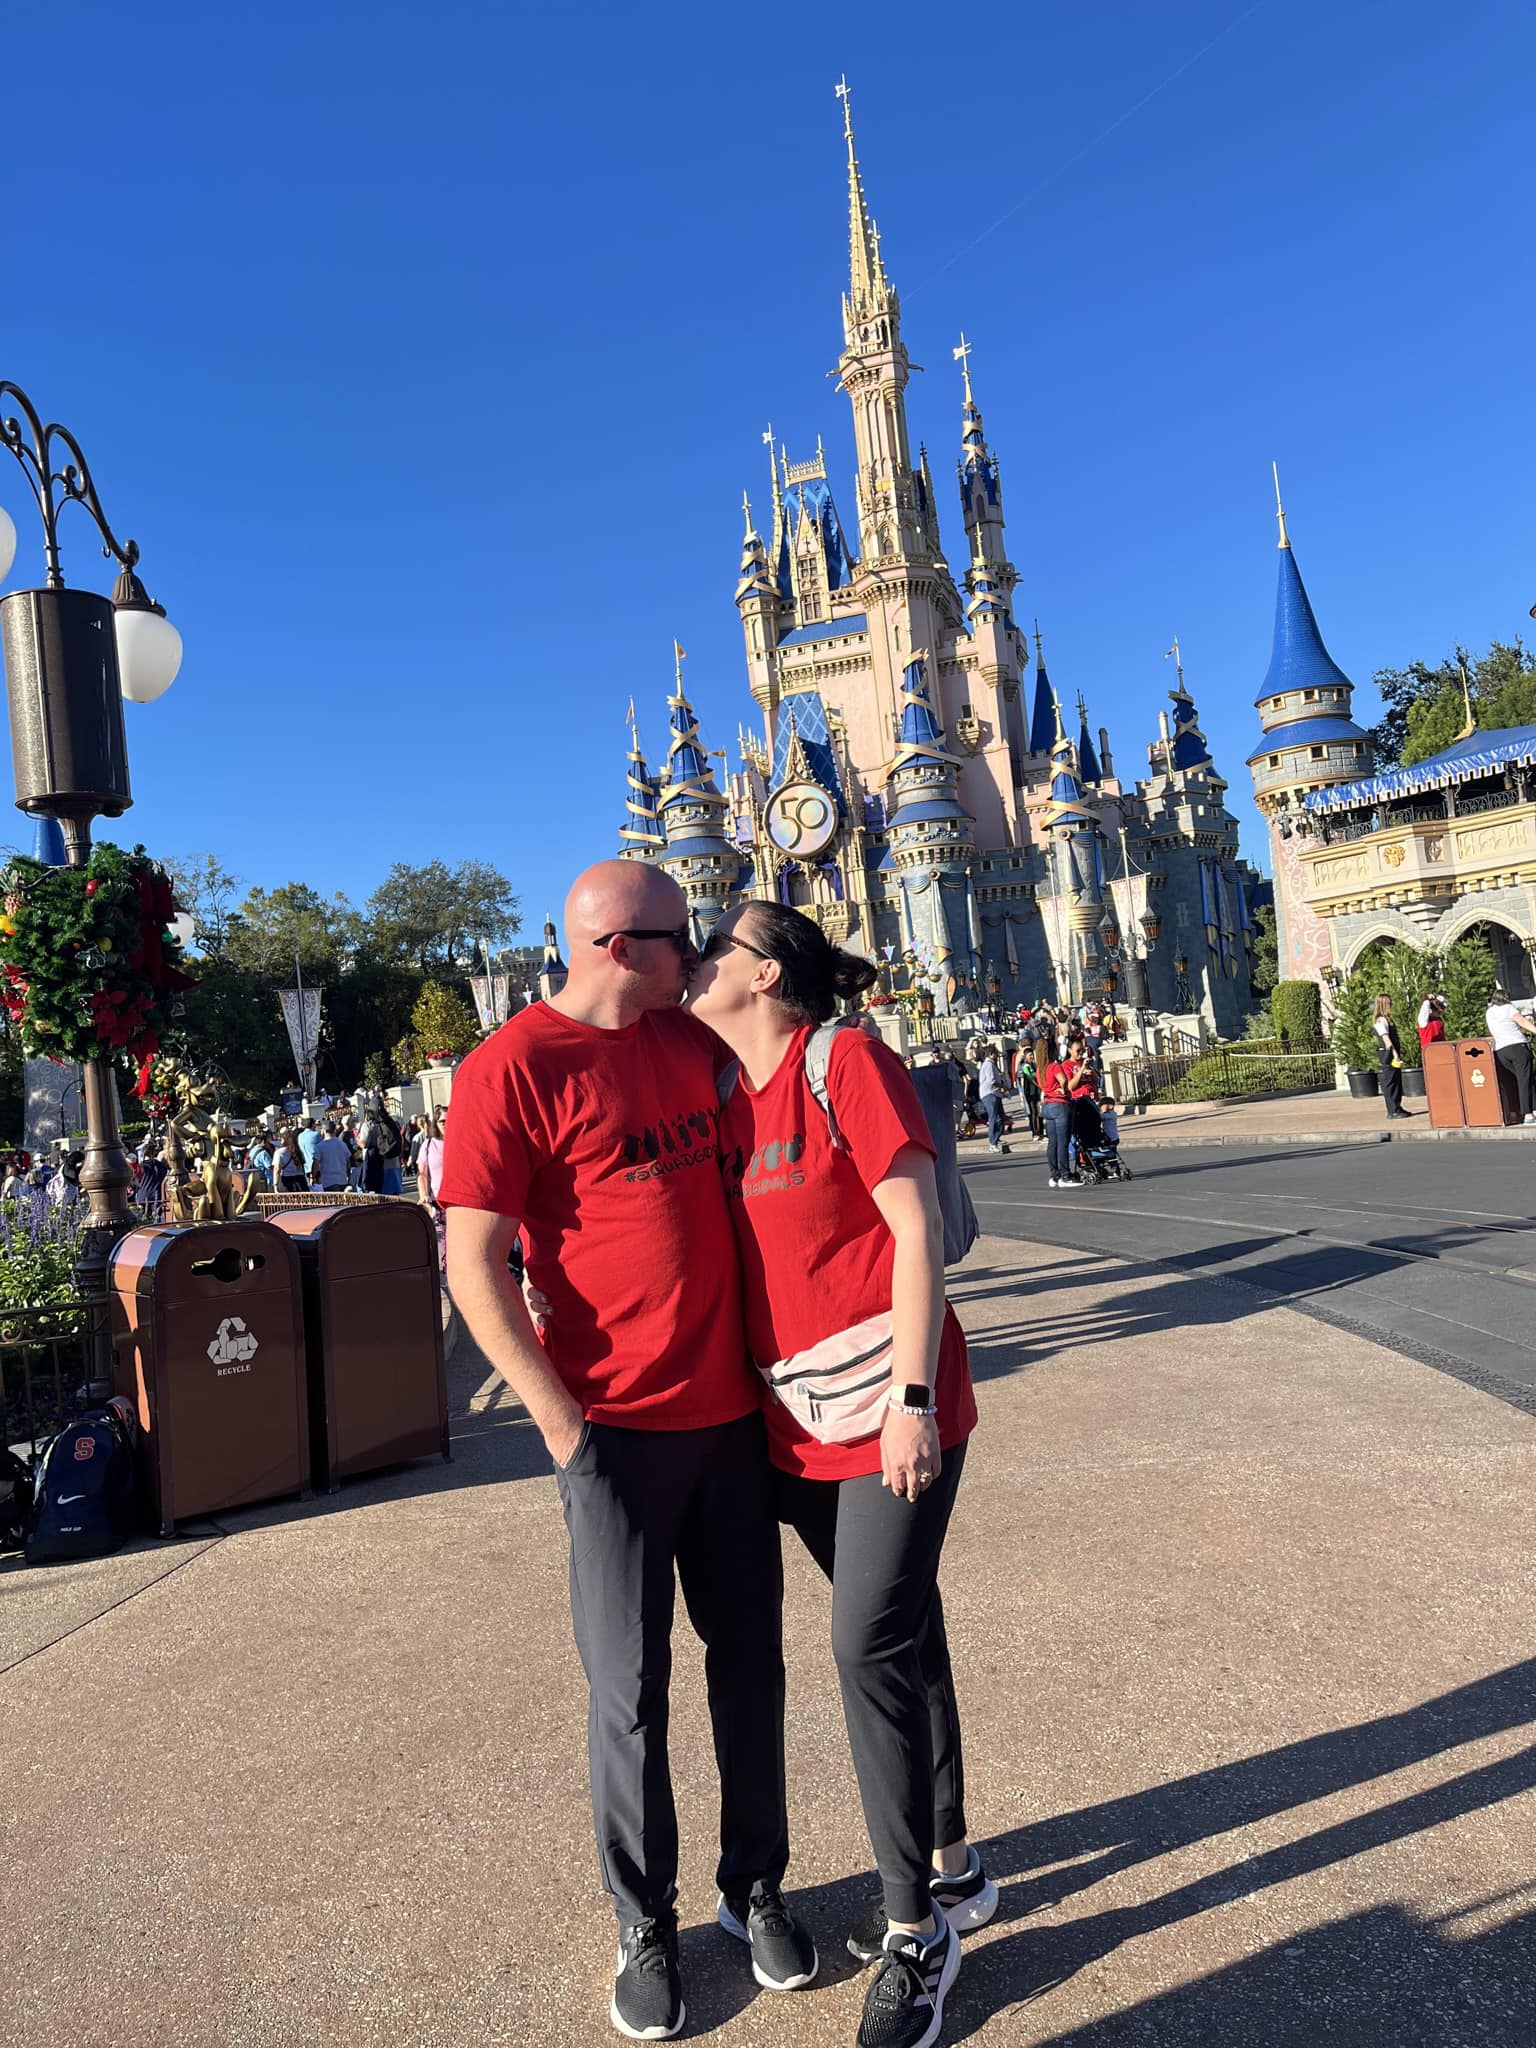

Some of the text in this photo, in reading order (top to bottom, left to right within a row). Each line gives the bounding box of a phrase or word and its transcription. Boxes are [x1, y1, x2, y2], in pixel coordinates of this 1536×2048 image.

[780, 797, 828, 849] 50
[217, 1364, 251, 1376] RECYCLE
[74, 1437, 95, 1461] S
